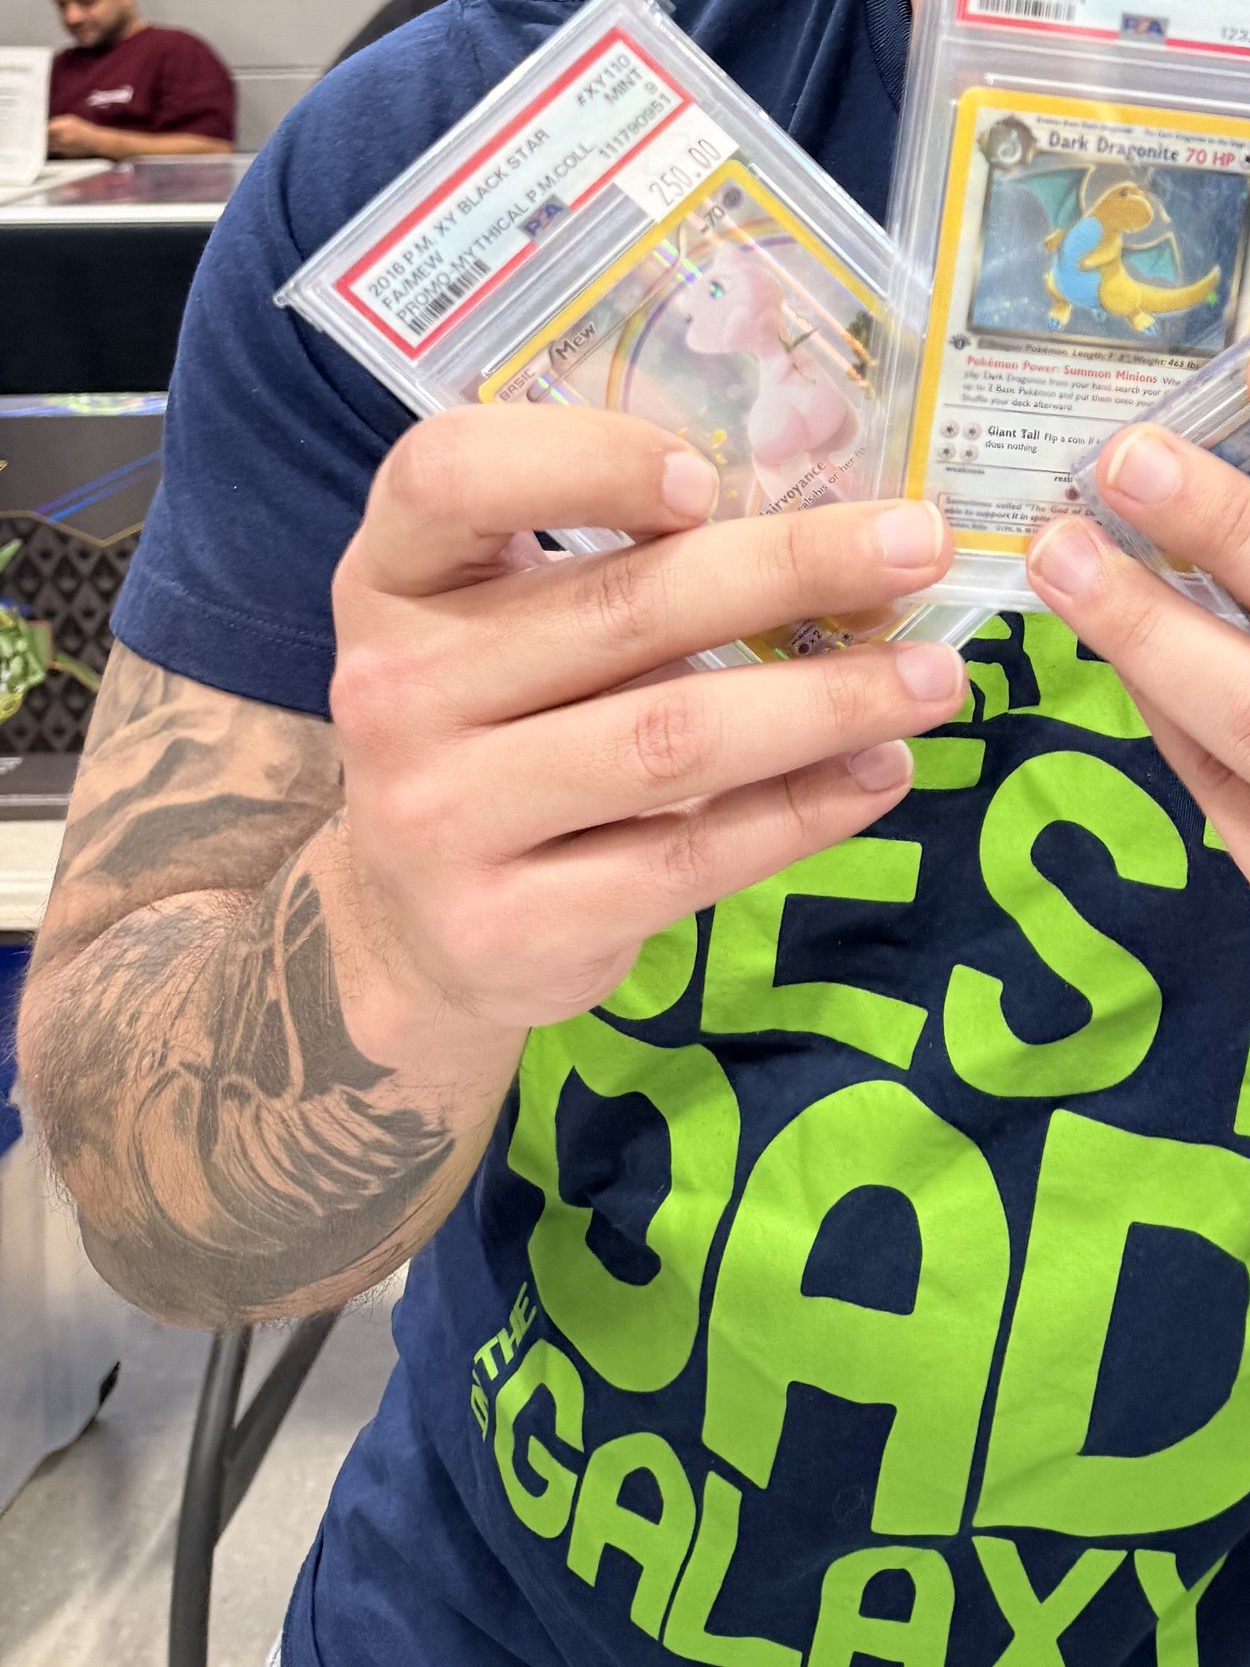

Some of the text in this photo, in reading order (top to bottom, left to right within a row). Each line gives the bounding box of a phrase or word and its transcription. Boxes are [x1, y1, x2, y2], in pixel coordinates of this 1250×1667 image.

[576, 53, 631, 106] #XY110
[604, 67, 643, 104] MINT
[649, 138, 721, 206] 250.00
[1049, 132, 1088, 150] Dark
[1097, 137, 1178, 164] Dragonite
[1185, 148, 1206, 163] 70
[1213, 153, 1234, 166] HP
[368, 261, 407, 298] 2016
[433, 212, 460, 237] XY
[458, 166, 508, 214] BLACK
[506, 128, 550, 169] STAR
[382, 251, 444, 310] FA/MEW
[396, 199, 529, 324] PROMO-MYTHICAL
[555, 323, 597, 361] Mew
[498, 369, 537, 402] BASIC
[967, 354, 1018, 370] Pokémon
[1022, 360, 1060, 373] Power:
[1063, 364, 1111, 379] Summon
[1115, 370, 1159, 384] Minions
[987, 425, 1017, 439] Giant
[1020, 429, 1041, 441] Tail
[759, 460, 827, 515] airvoyance
[814, 484, 828, 498] his
[828, 472, 839, 485] or
[838, 456, 855, 474] her
[473, 1281, 538, 1382] THE
[495, 1337, 1232, 1667] GALAXY
